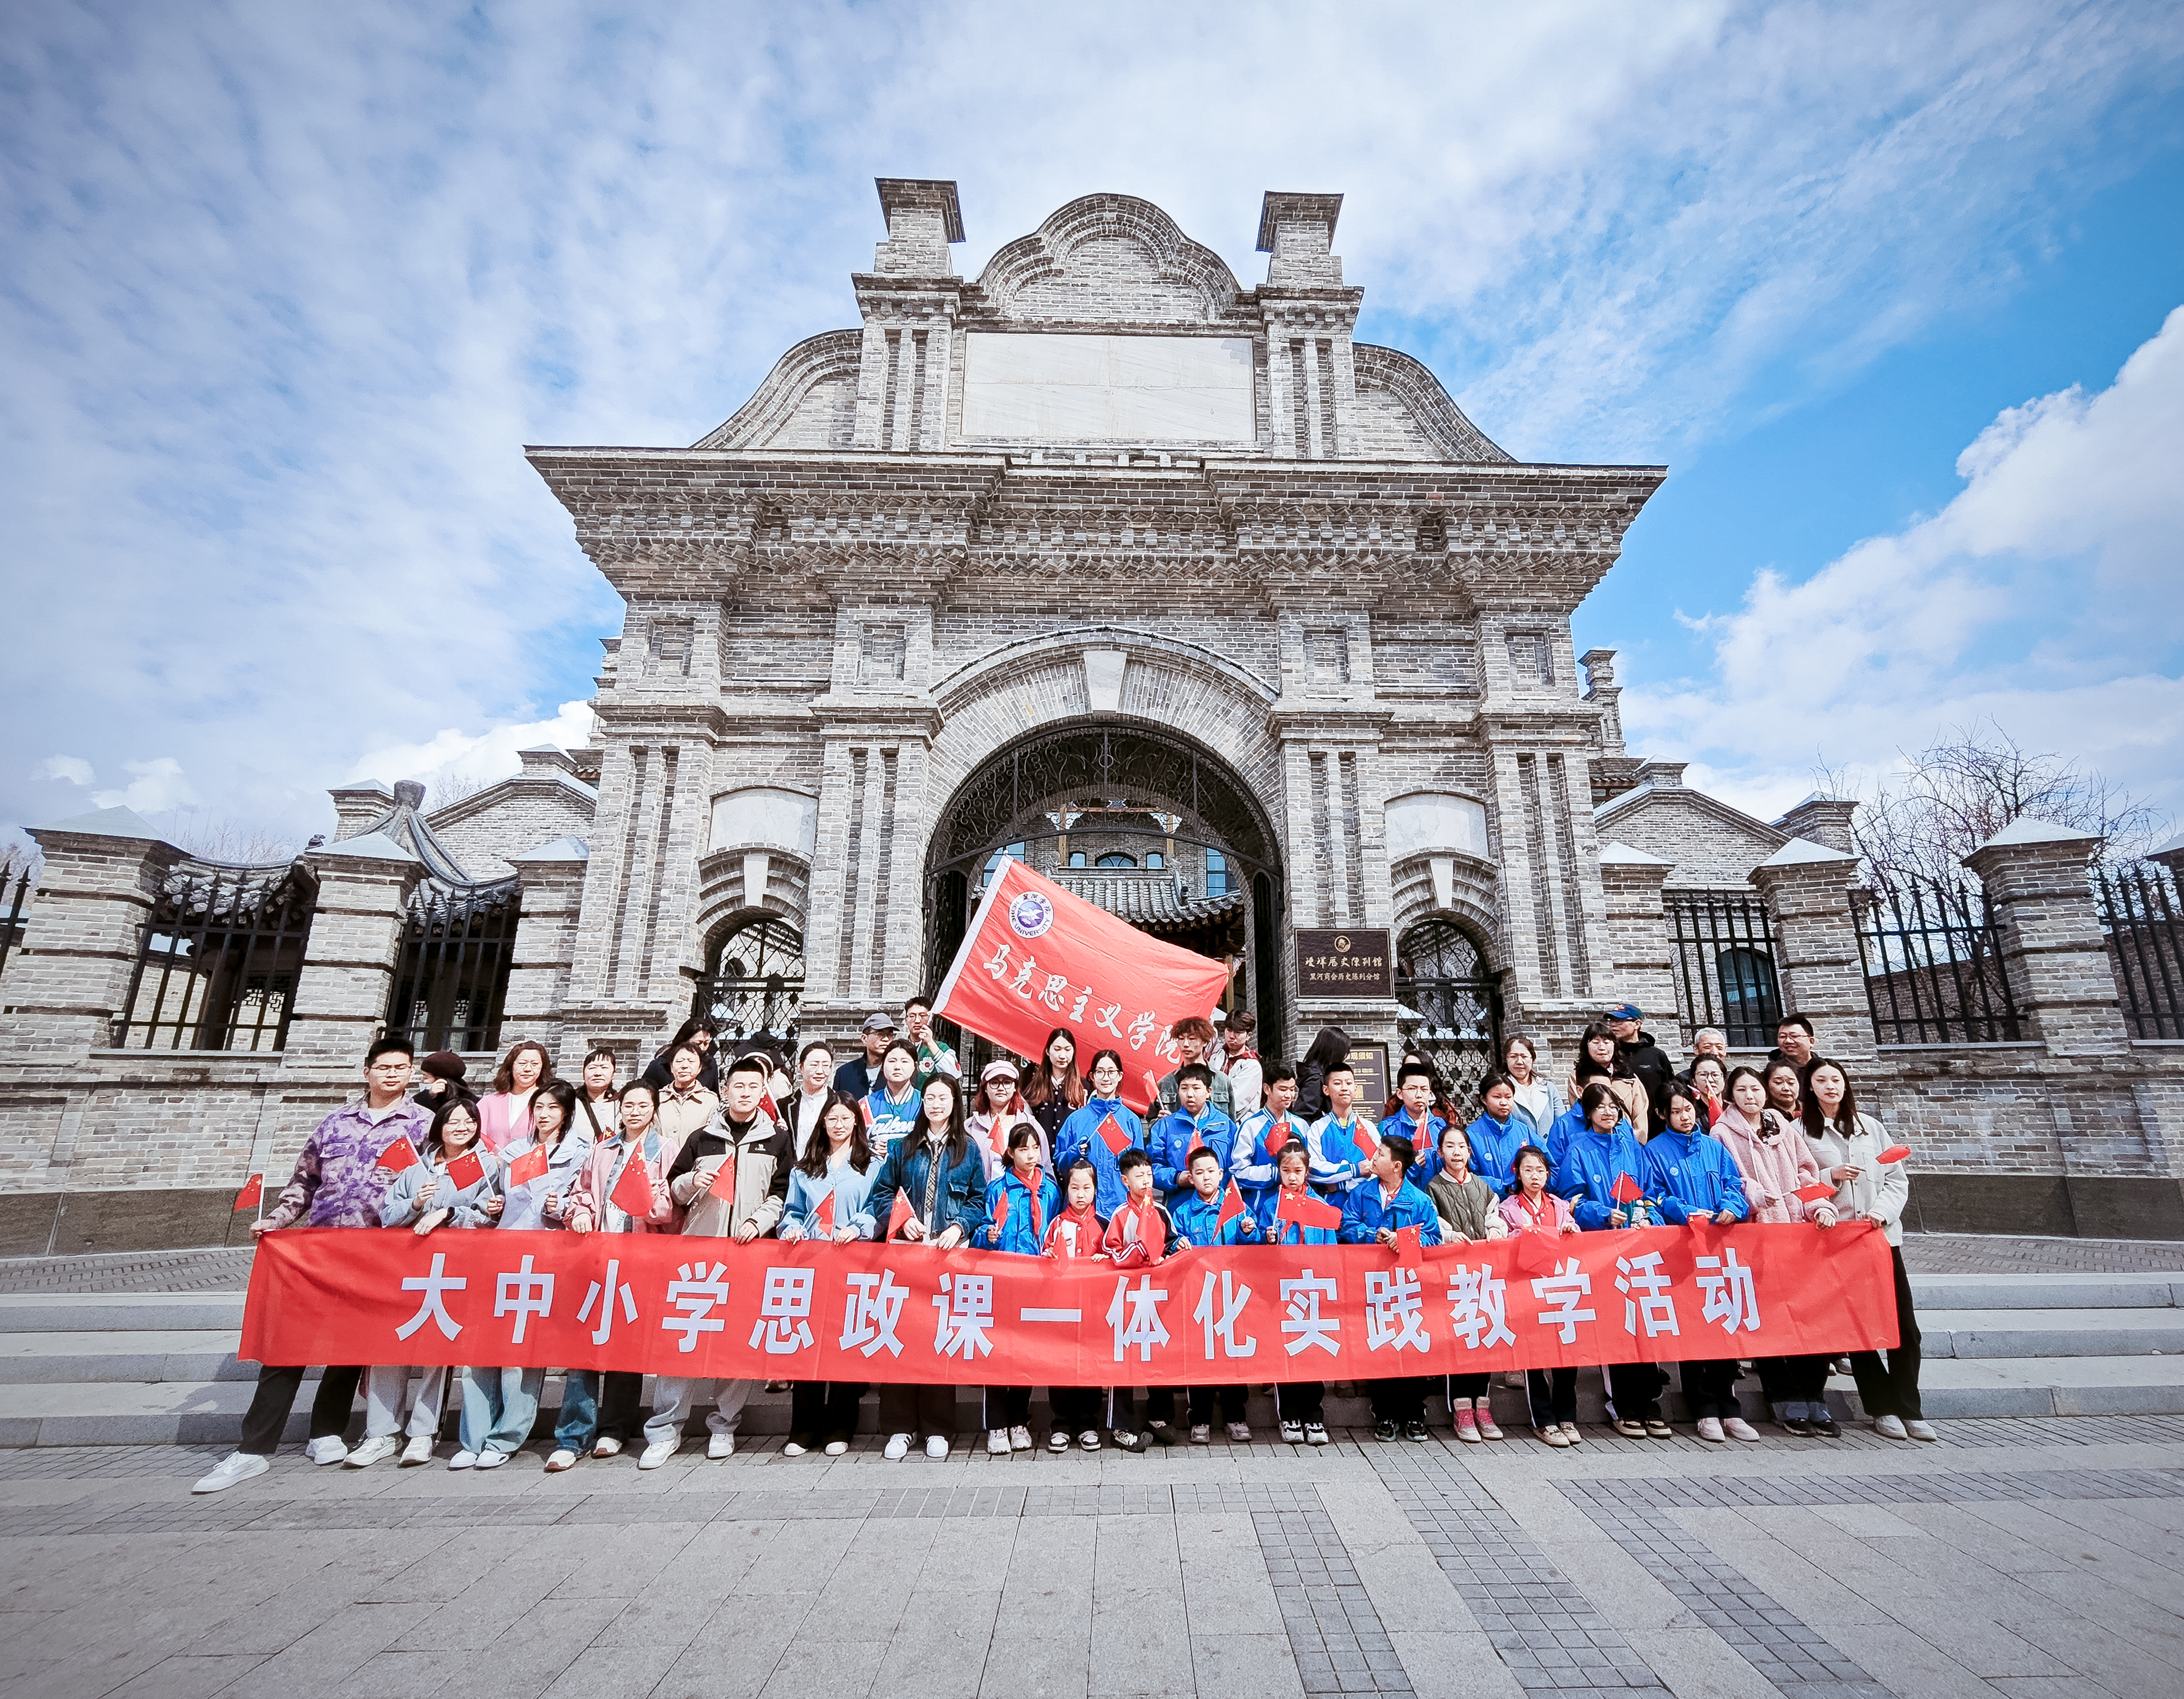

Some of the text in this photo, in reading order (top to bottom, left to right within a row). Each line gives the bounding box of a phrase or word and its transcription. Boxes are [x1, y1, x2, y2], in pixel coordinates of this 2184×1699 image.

[1011, 901, 1050, 936] HEIHE UNIVERSITY
[394, 1252, 1761, 1363] 大中小学思政课一体化实践教学活动
